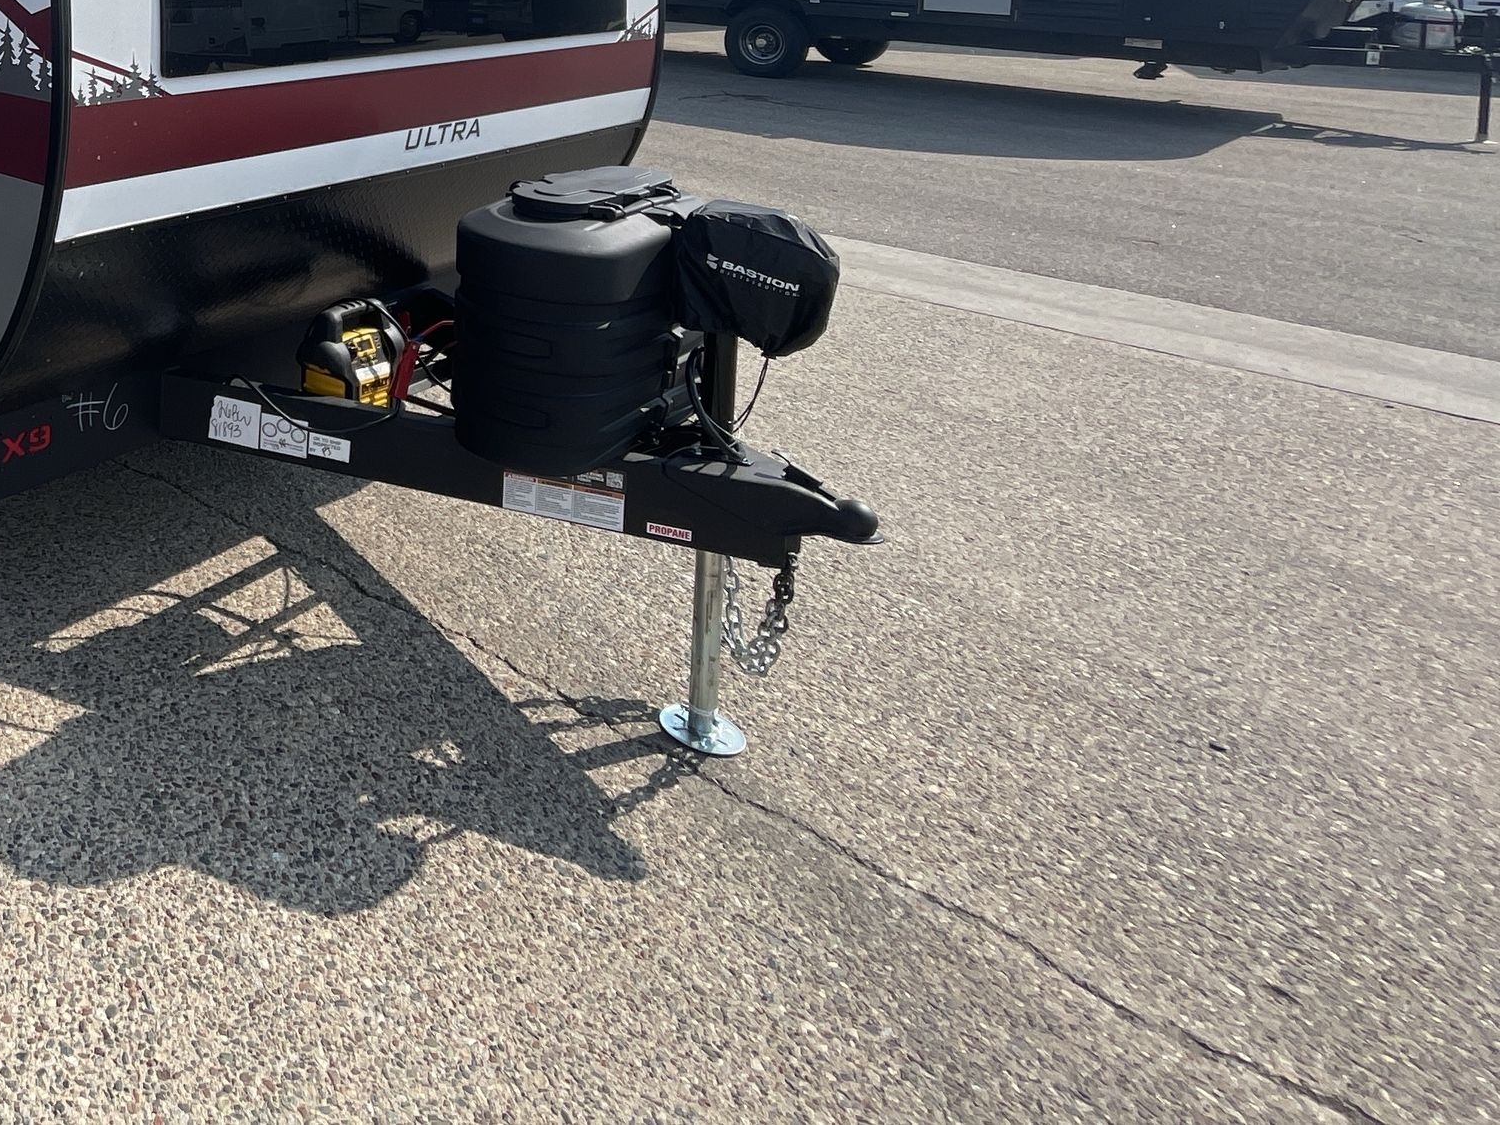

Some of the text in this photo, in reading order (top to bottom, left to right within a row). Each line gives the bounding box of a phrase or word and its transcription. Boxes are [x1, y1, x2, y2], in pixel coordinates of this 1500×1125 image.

[405, 119, 481, 150] ULTRA
[722, 261, 800, 292] BASTION
[66, 382, 129, 431] #6
[649, 524, 692, 541] PROPANE
